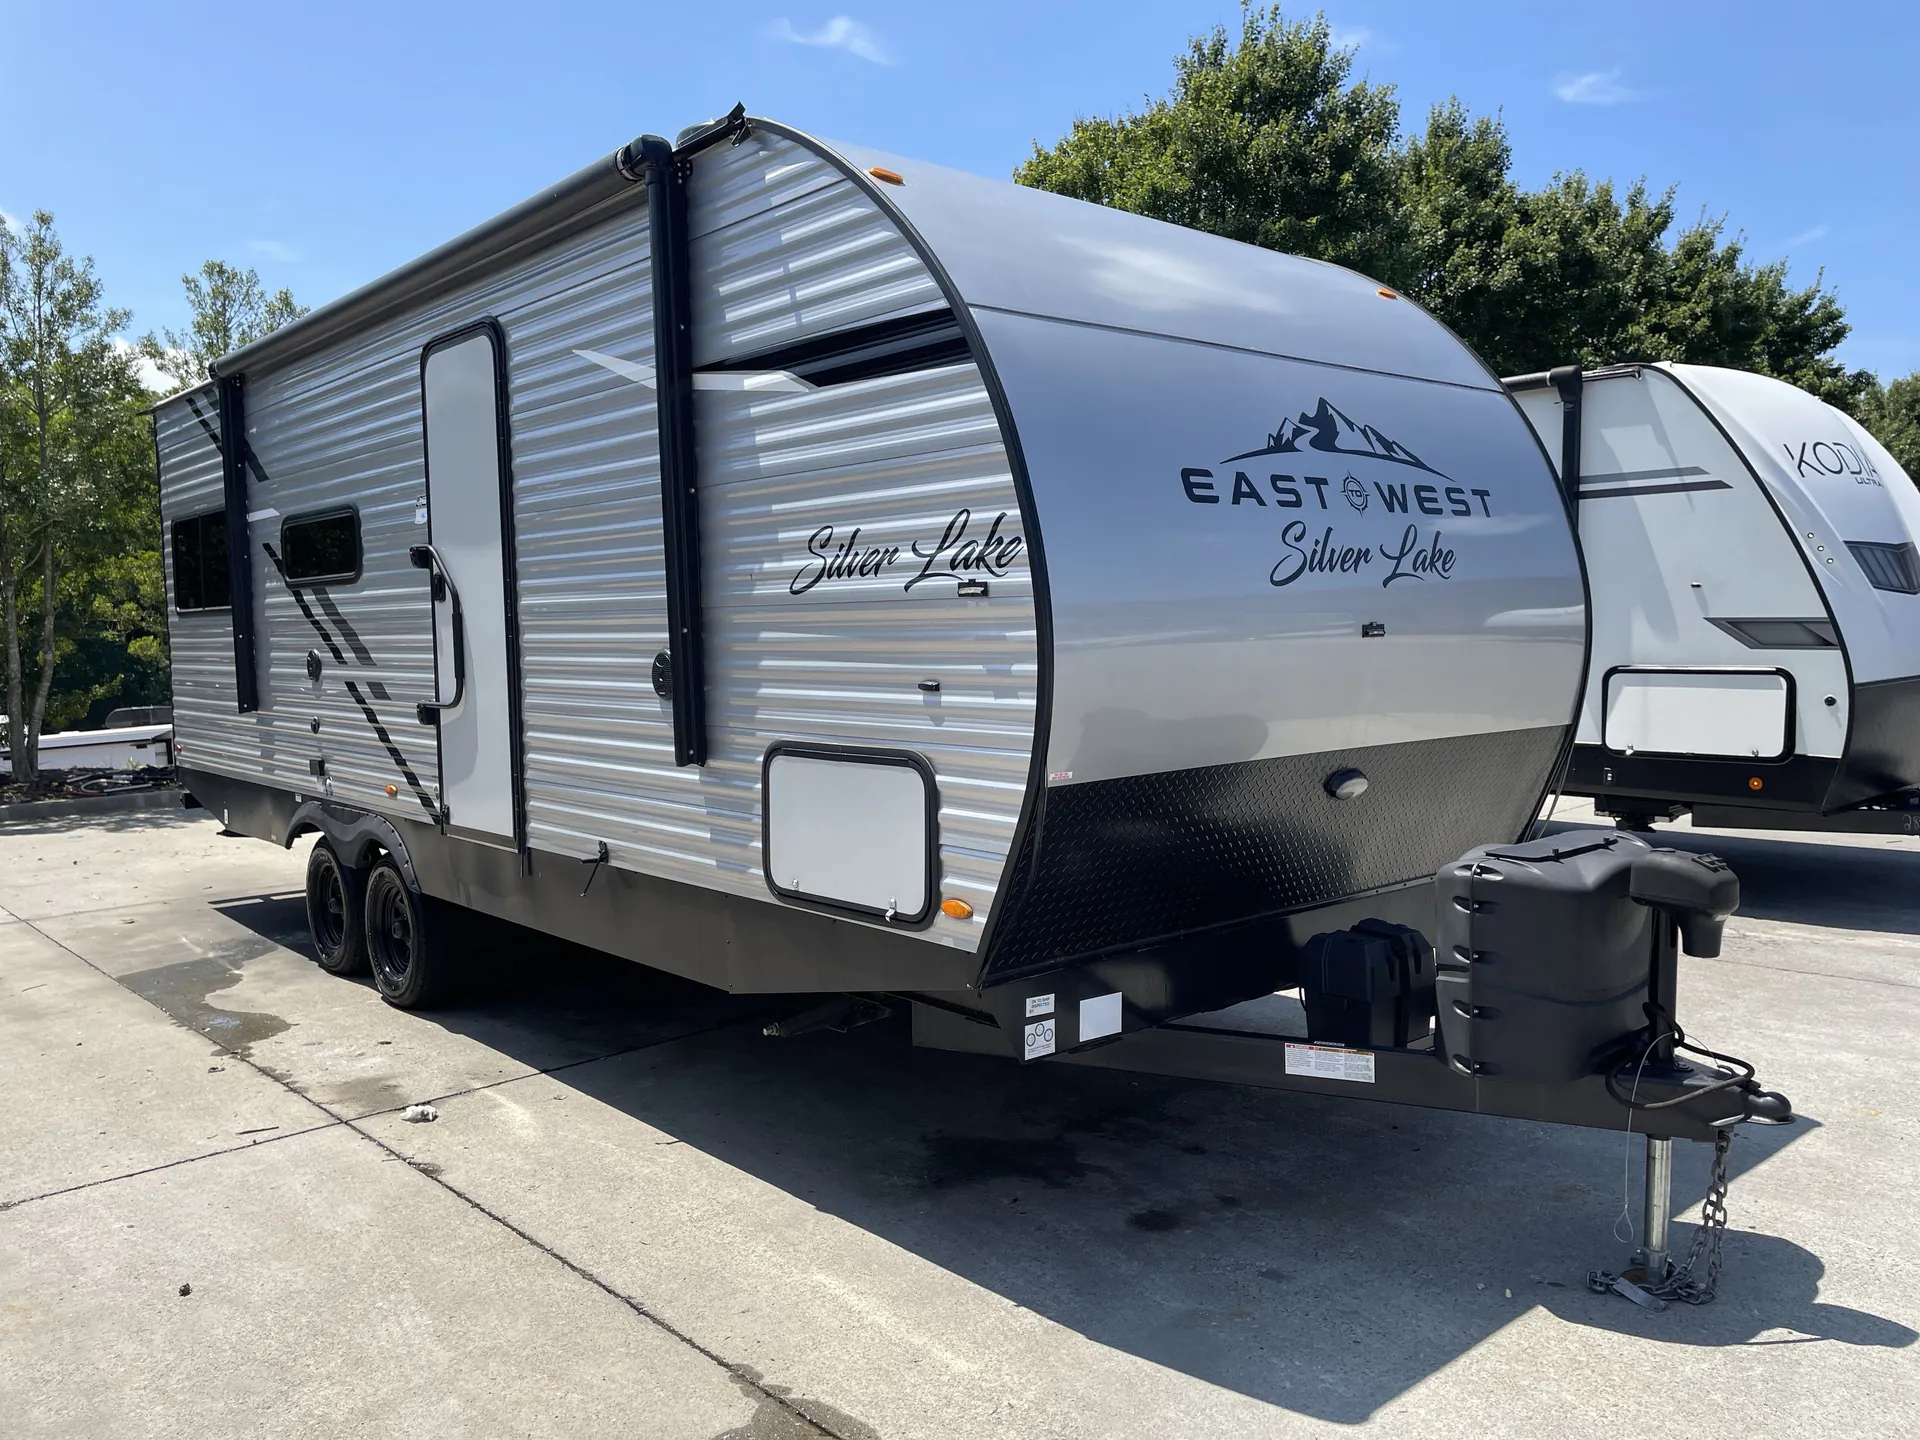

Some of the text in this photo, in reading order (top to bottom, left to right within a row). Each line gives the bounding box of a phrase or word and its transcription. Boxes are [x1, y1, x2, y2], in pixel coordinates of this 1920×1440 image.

[1180, 467, 1492, 518] EAST TO WEST
[789, 508, 1024, 595] Silver Lake
[1269, 520, 1457, 588] Silver Lake
